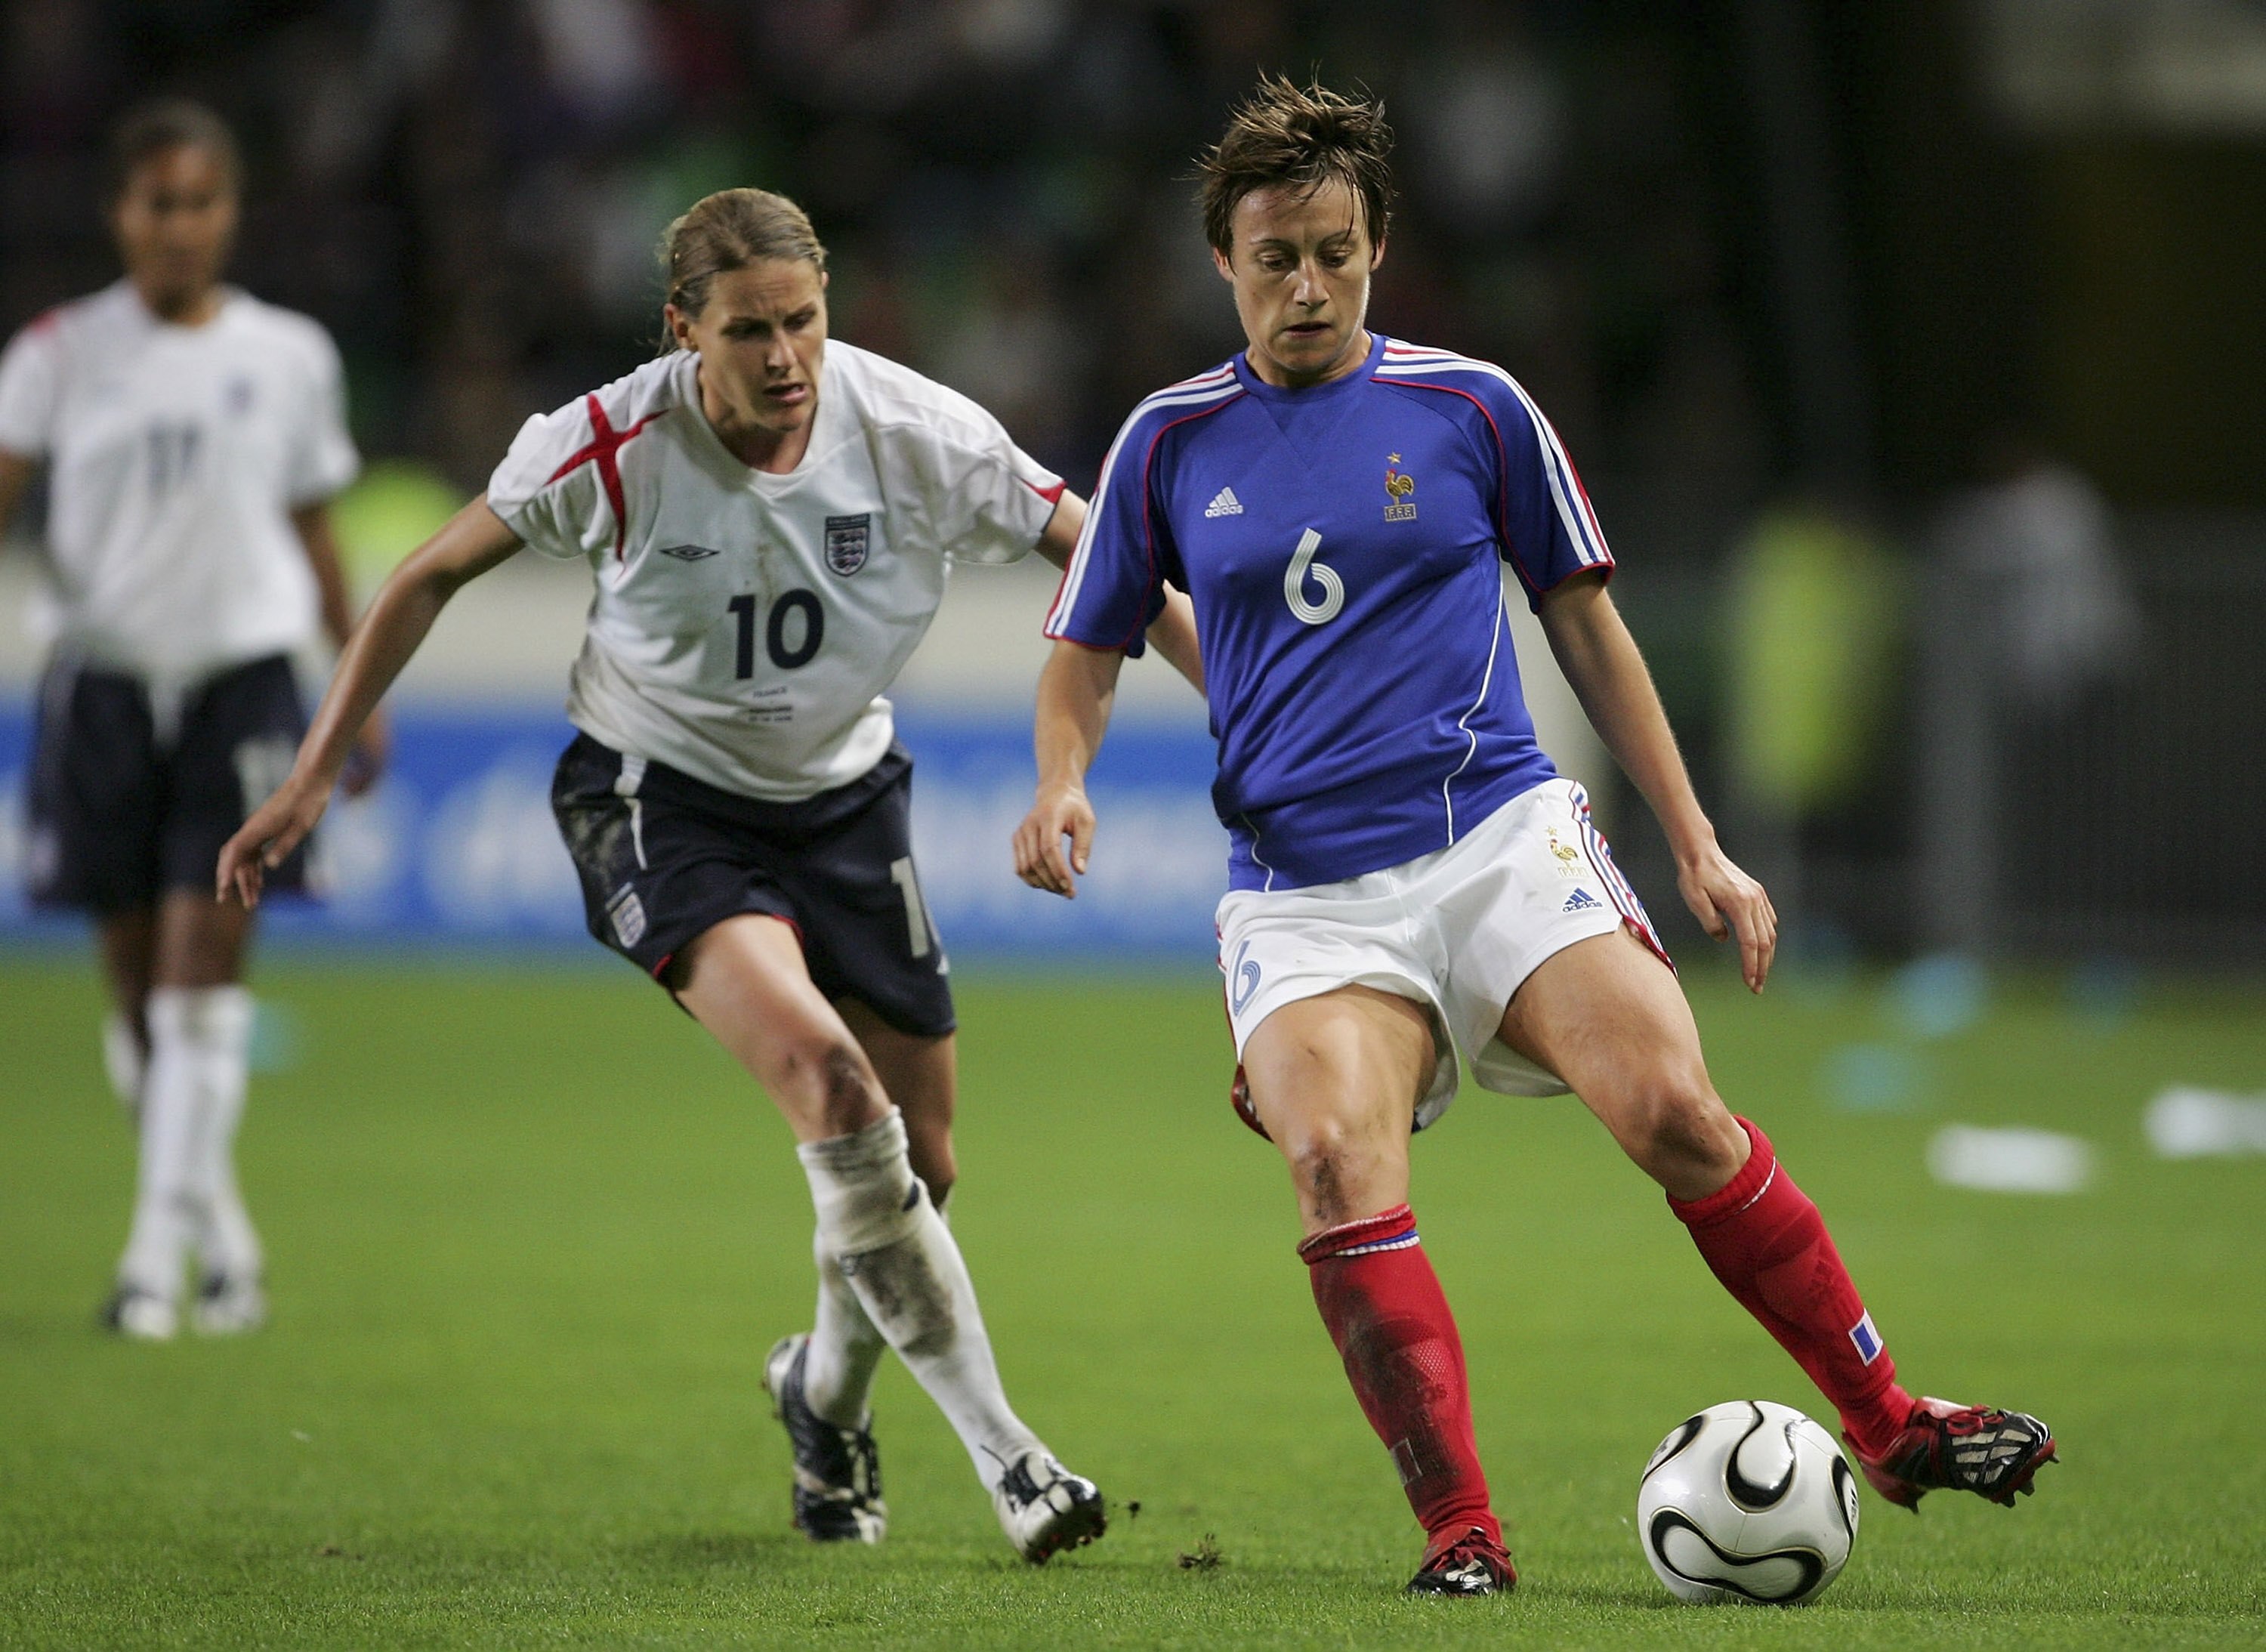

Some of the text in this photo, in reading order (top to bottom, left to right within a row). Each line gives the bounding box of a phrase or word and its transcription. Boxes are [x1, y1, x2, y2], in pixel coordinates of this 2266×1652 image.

[1205, 504, 1243, 517] adidas
[1284, 527, 1344, 625] 6
[727, 588, 824, 680] 10
[1563, 900, 1602, 912] adidas
[1233, 940, 1261, 1017] 6
